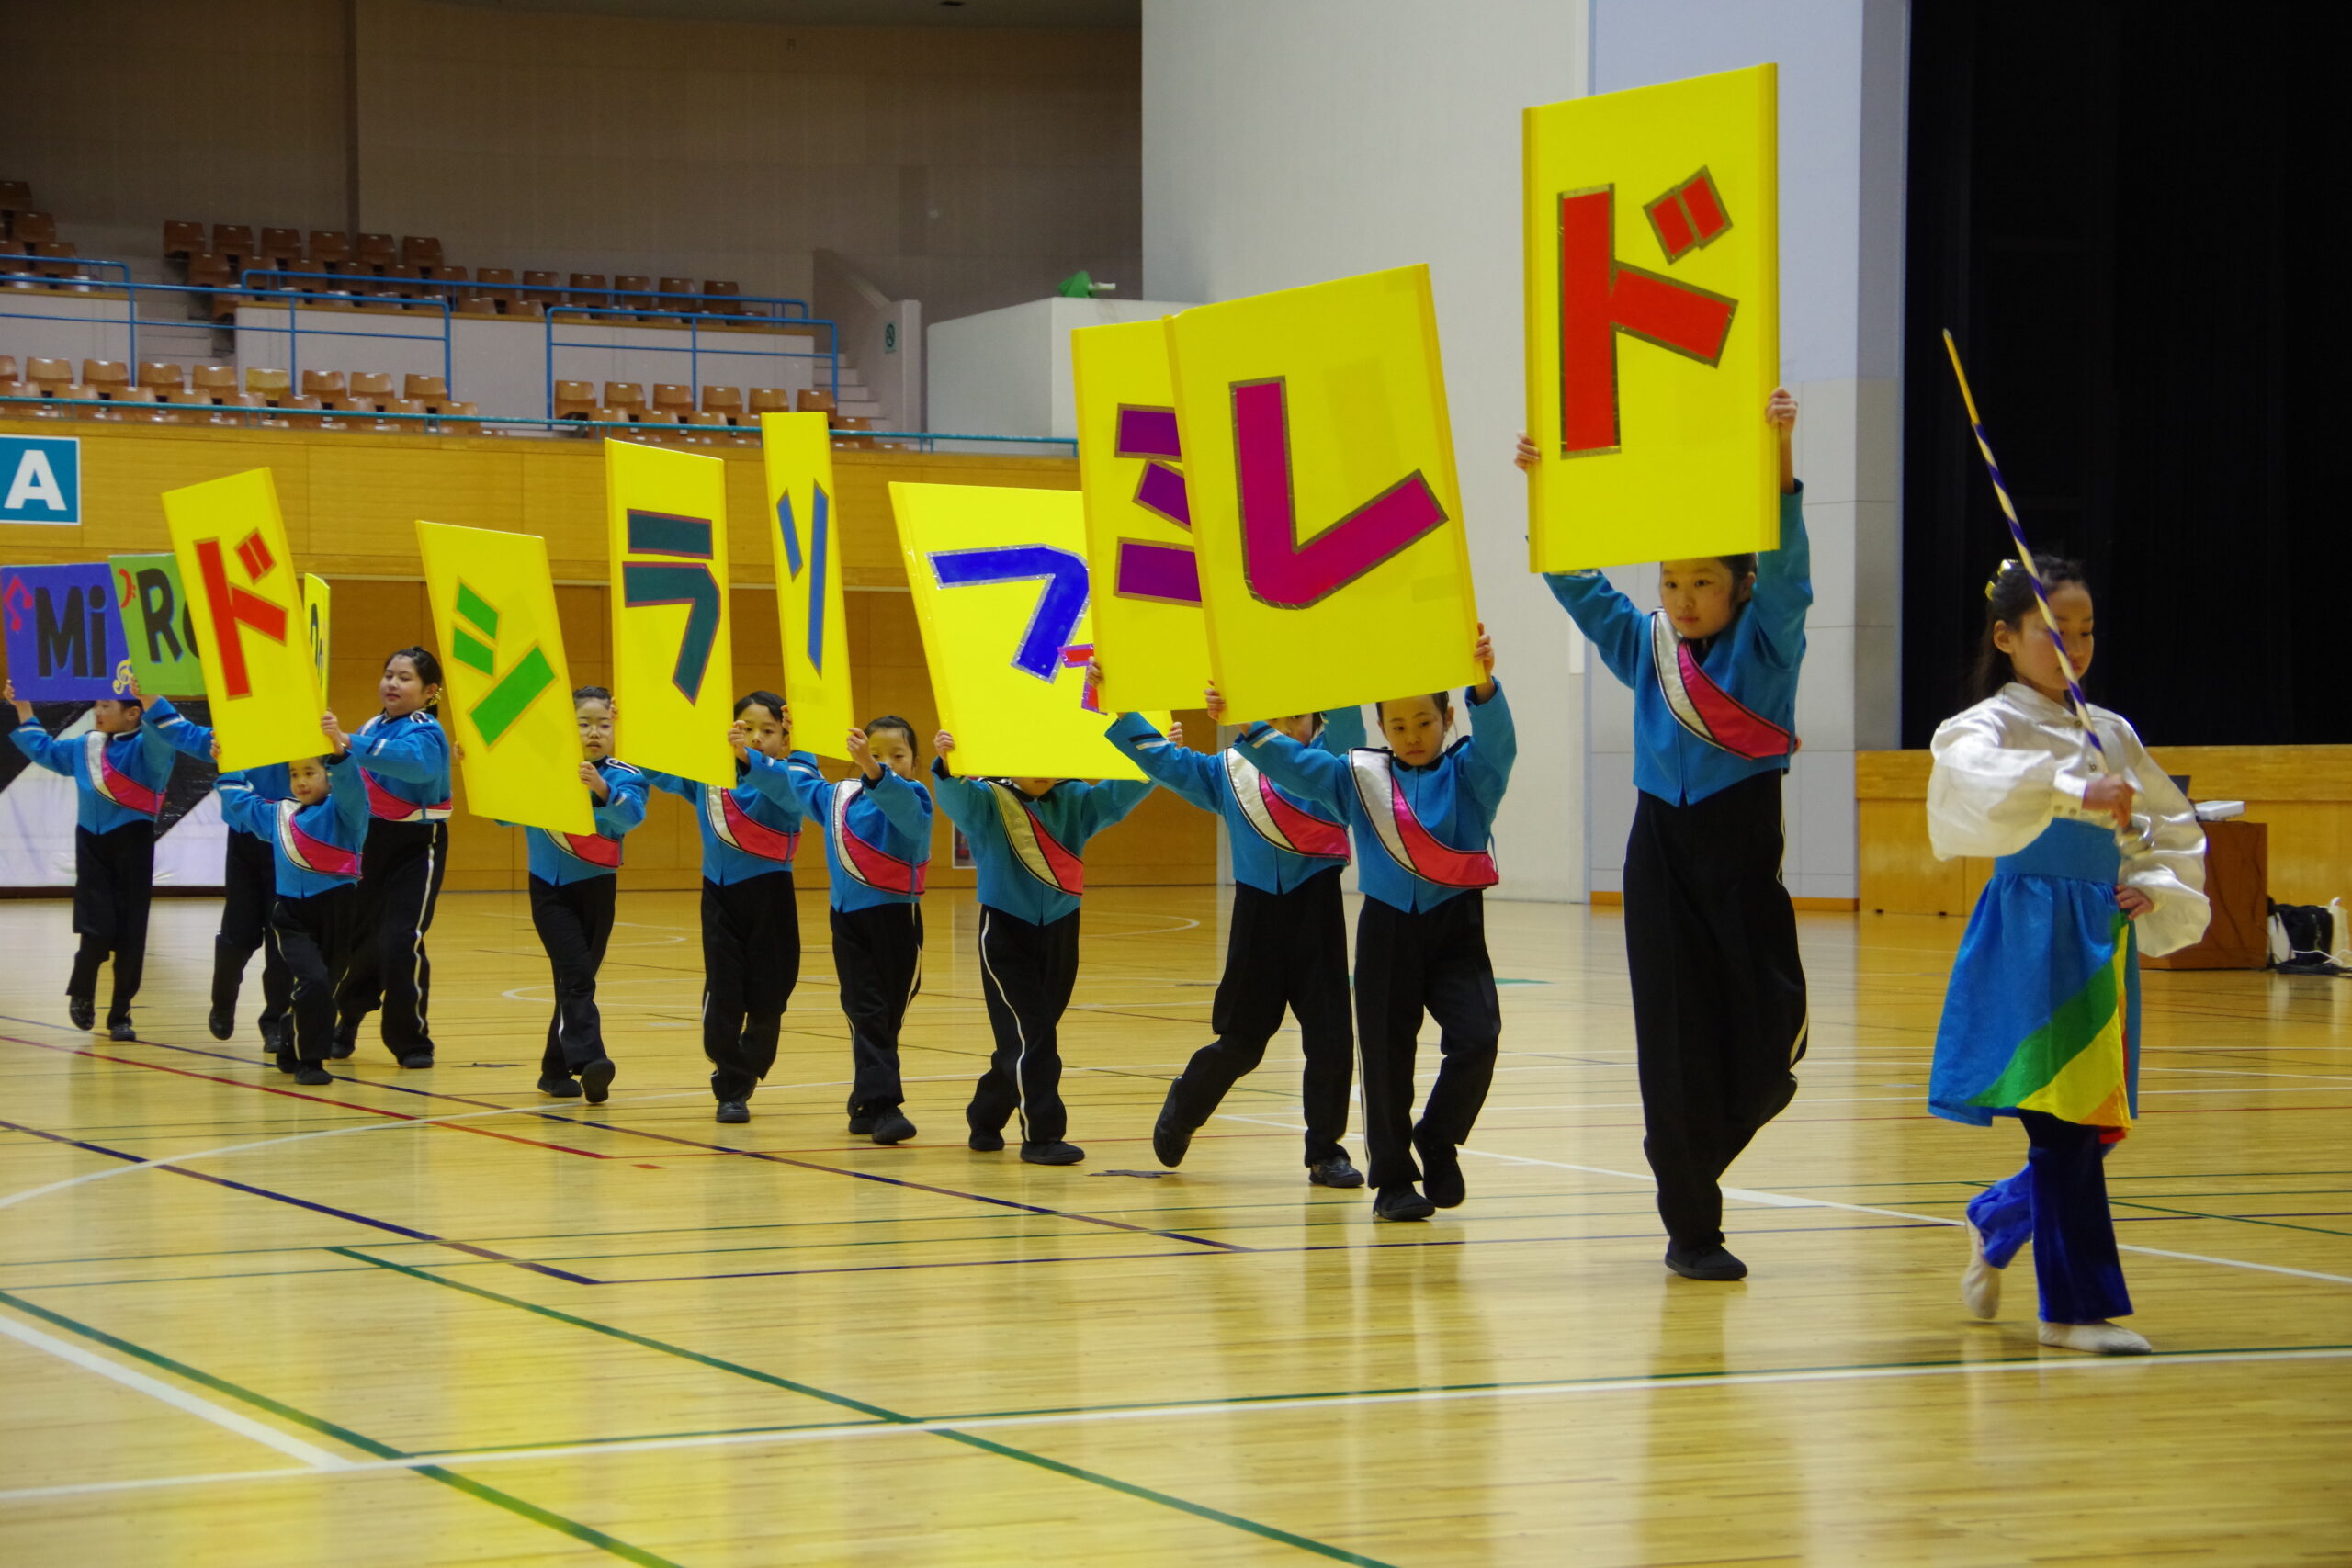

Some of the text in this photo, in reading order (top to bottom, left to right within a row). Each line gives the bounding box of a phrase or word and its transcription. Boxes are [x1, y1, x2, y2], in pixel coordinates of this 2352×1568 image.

[1557, 164, 1739, 461] ド
[4, 449, 68, 511] A
[1228, 375, 1449, 611] レ
[35, 585, 108, 680] Mi
[194, 528, 288, 701] ド
[452, 576, 559, 750] シ
[622, 507, 722, 707] ラ
[776, 478, 829, 680] ソ
